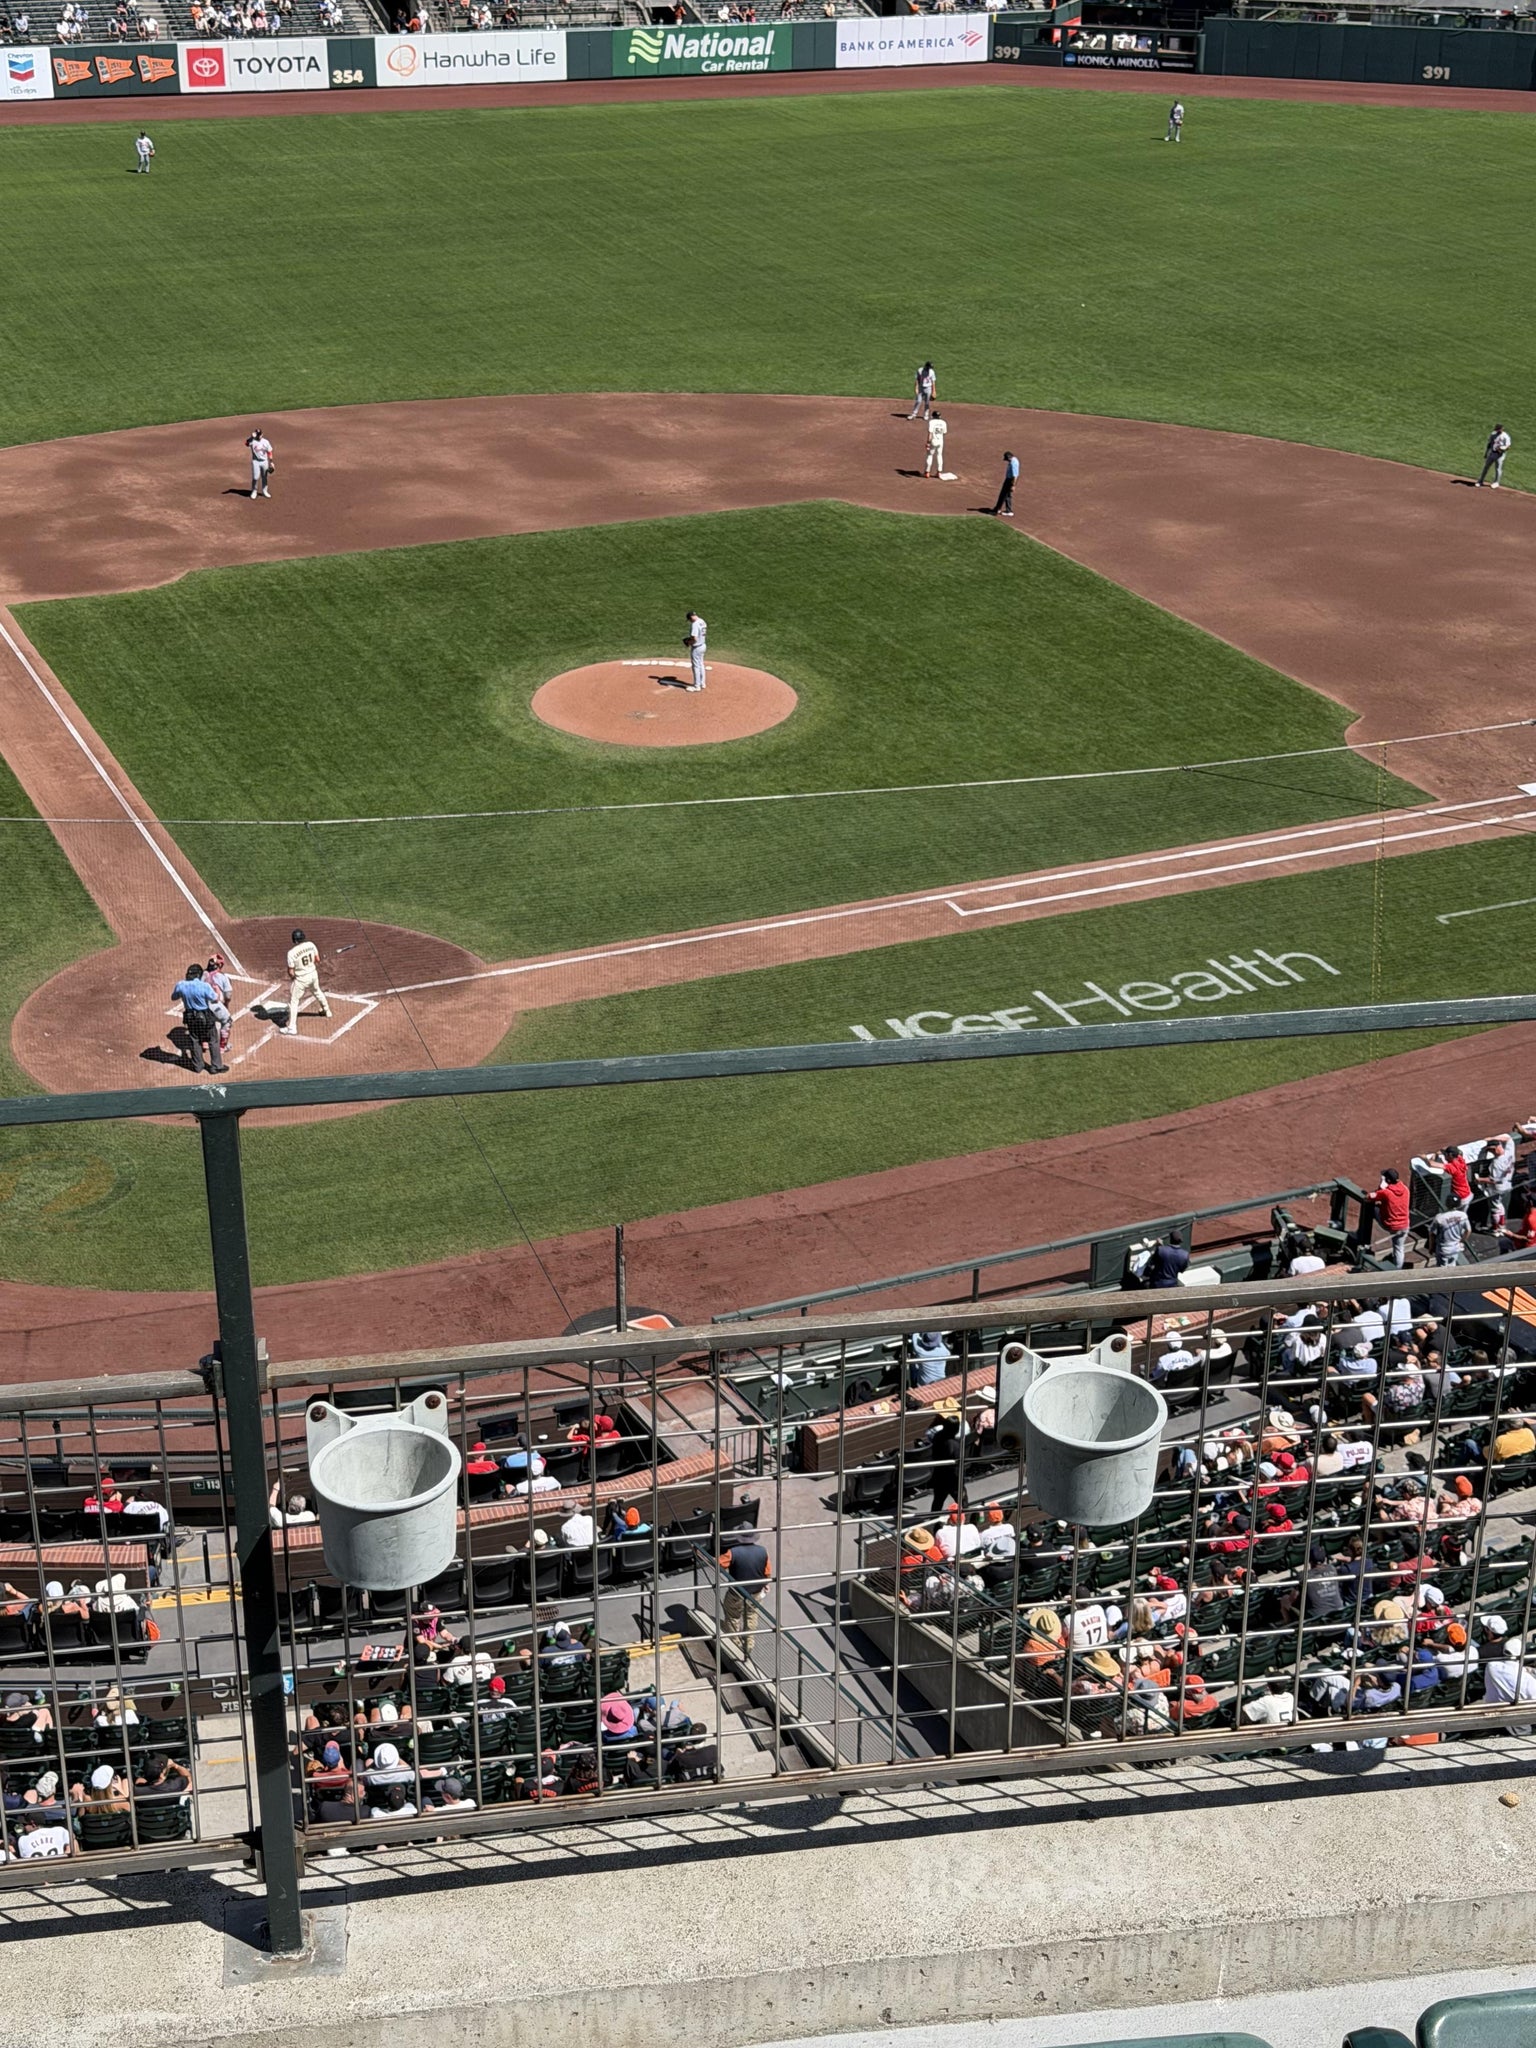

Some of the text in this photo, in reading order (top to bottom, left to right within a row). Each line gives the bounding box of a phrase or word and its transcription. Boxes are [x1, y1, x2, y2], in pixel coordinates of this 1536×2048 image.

[664, 30, 774, 59] National
[840, 37, 955, 52] BANK OF AMERICA
[424, 48, 556, 68] Hanwha Life
[994, 46, 1020, 60] 399
[233, 55, 322, 75] TOYOTA
[701, 57, 769, 72] Car Rental
[1077, 54, 1116, 67] KONICA
[1117, 57, 1160, 70] MINOLTA
[332, 69, 365, 84] 354
[1422, 64, 1451, 81] 391
[301, 953, 313, 967] 61
[1032, 948, 1342, 1027] Health
[1086, 1626, 1102, 1645] 17
